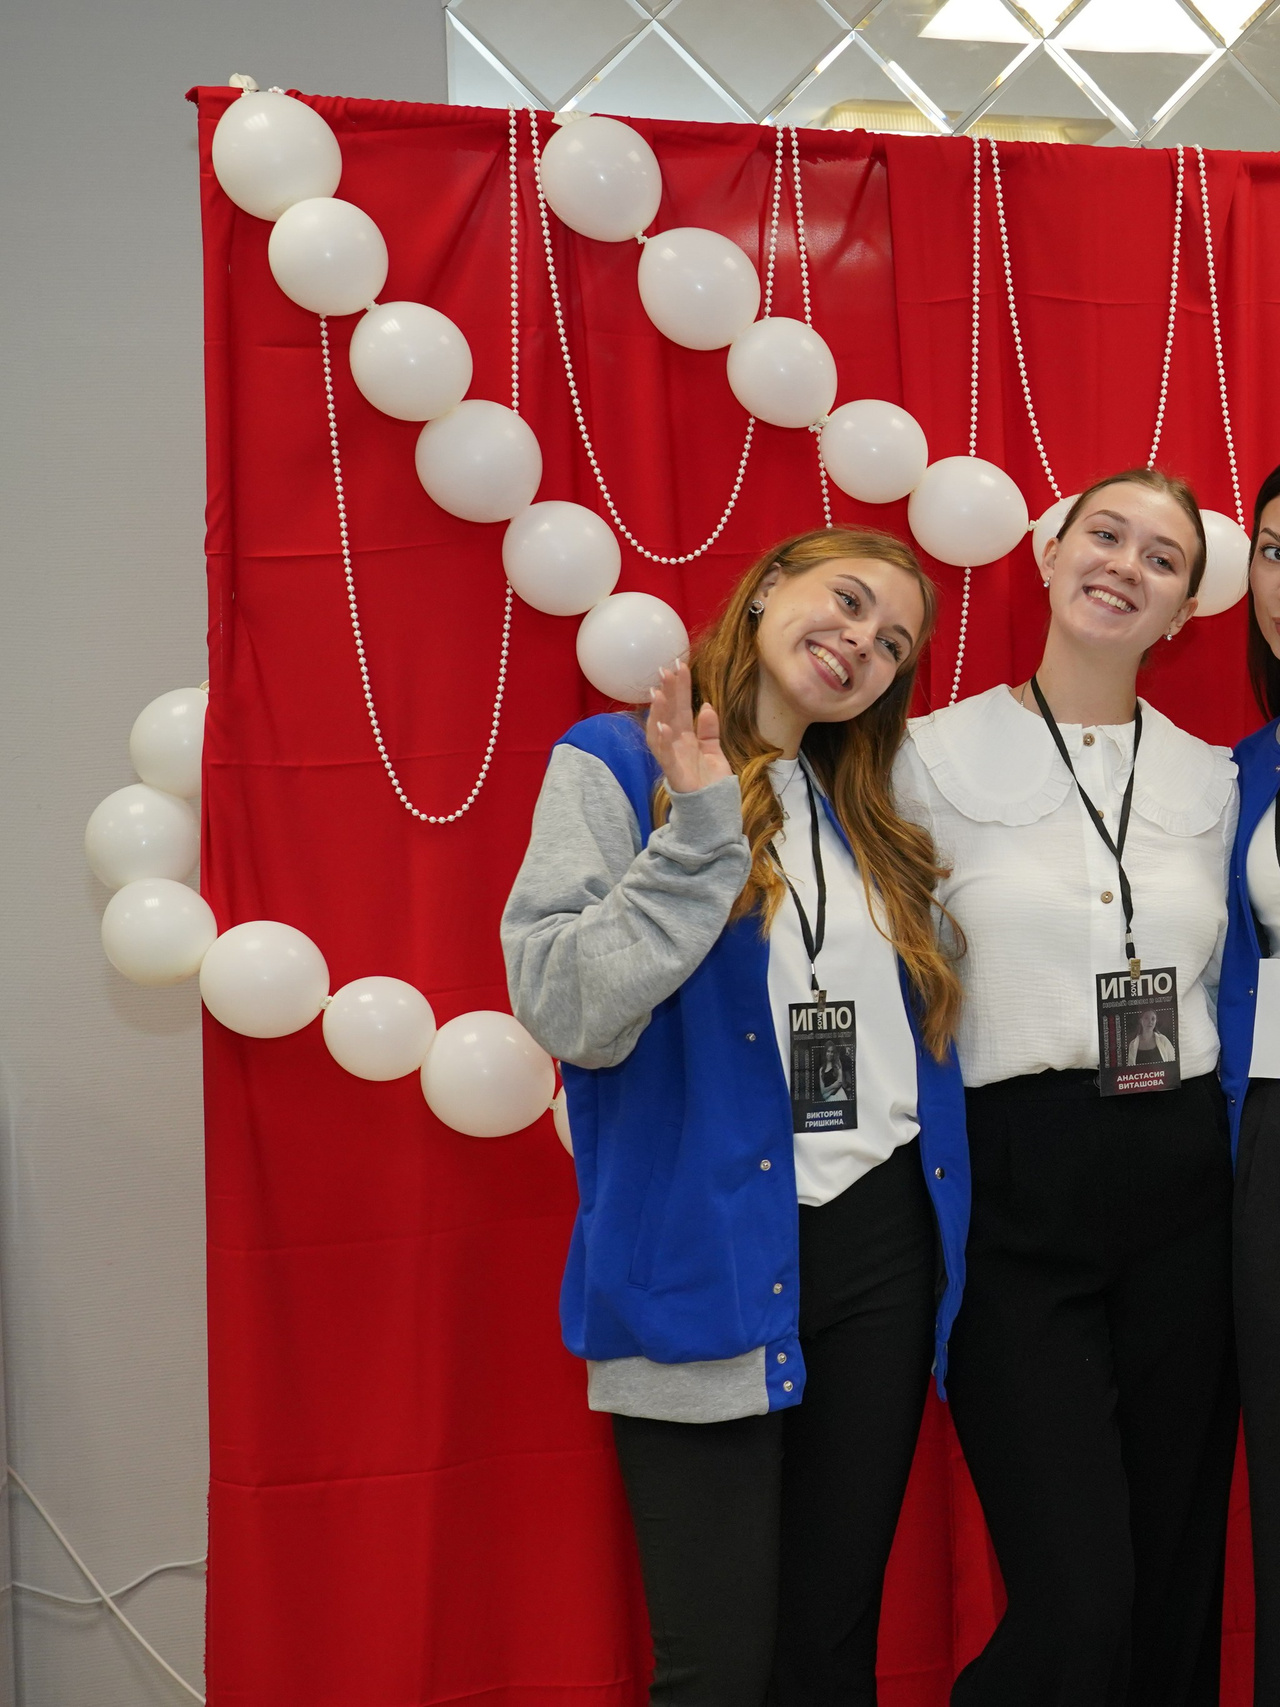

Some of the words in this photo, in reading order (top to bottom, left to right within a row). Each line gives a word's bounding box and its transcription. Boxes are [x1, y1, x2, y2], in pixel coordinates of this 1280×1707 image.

[1100, 972, 1173, 1000] ИГПО
[792, 1006, 852, 1031] ИГПО
[1117, 1070, 1165, 1082] АНАСТАСИЯ
[1118, 1079, 1164, 1090] ВИТАШОВА
[806, 1110, 843, 1119] ВИКТОРИЯ
[805, 1118, 844, 1128] ГРИШКИНА
